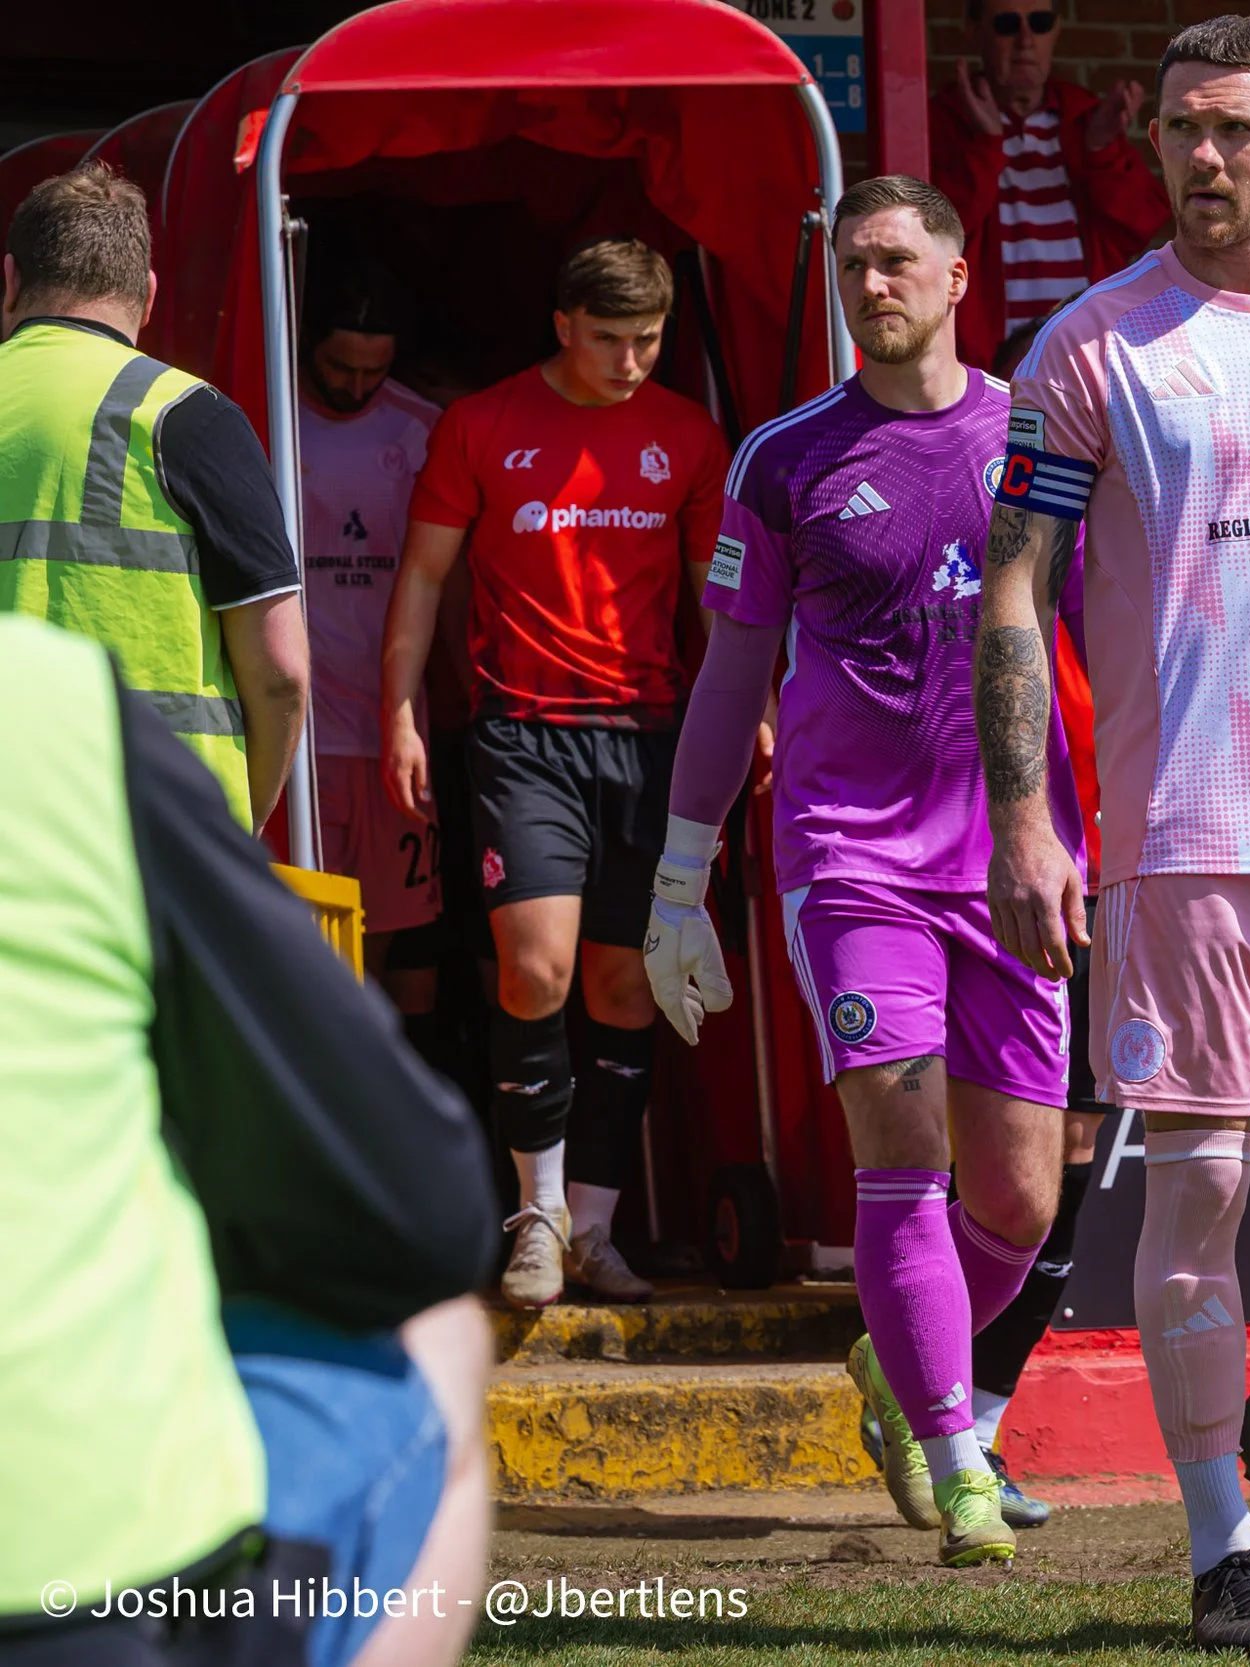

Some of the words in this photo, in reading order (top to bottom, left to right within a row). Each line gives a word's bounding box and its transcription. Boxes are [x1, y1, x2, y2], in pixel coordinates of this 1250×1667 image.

[802, 0, 816, 21] 2
[1003, 454, 1033, 496] C
[552, 503, 667, 533] phantom
[713, 559, 739, 574] ATIONAL
